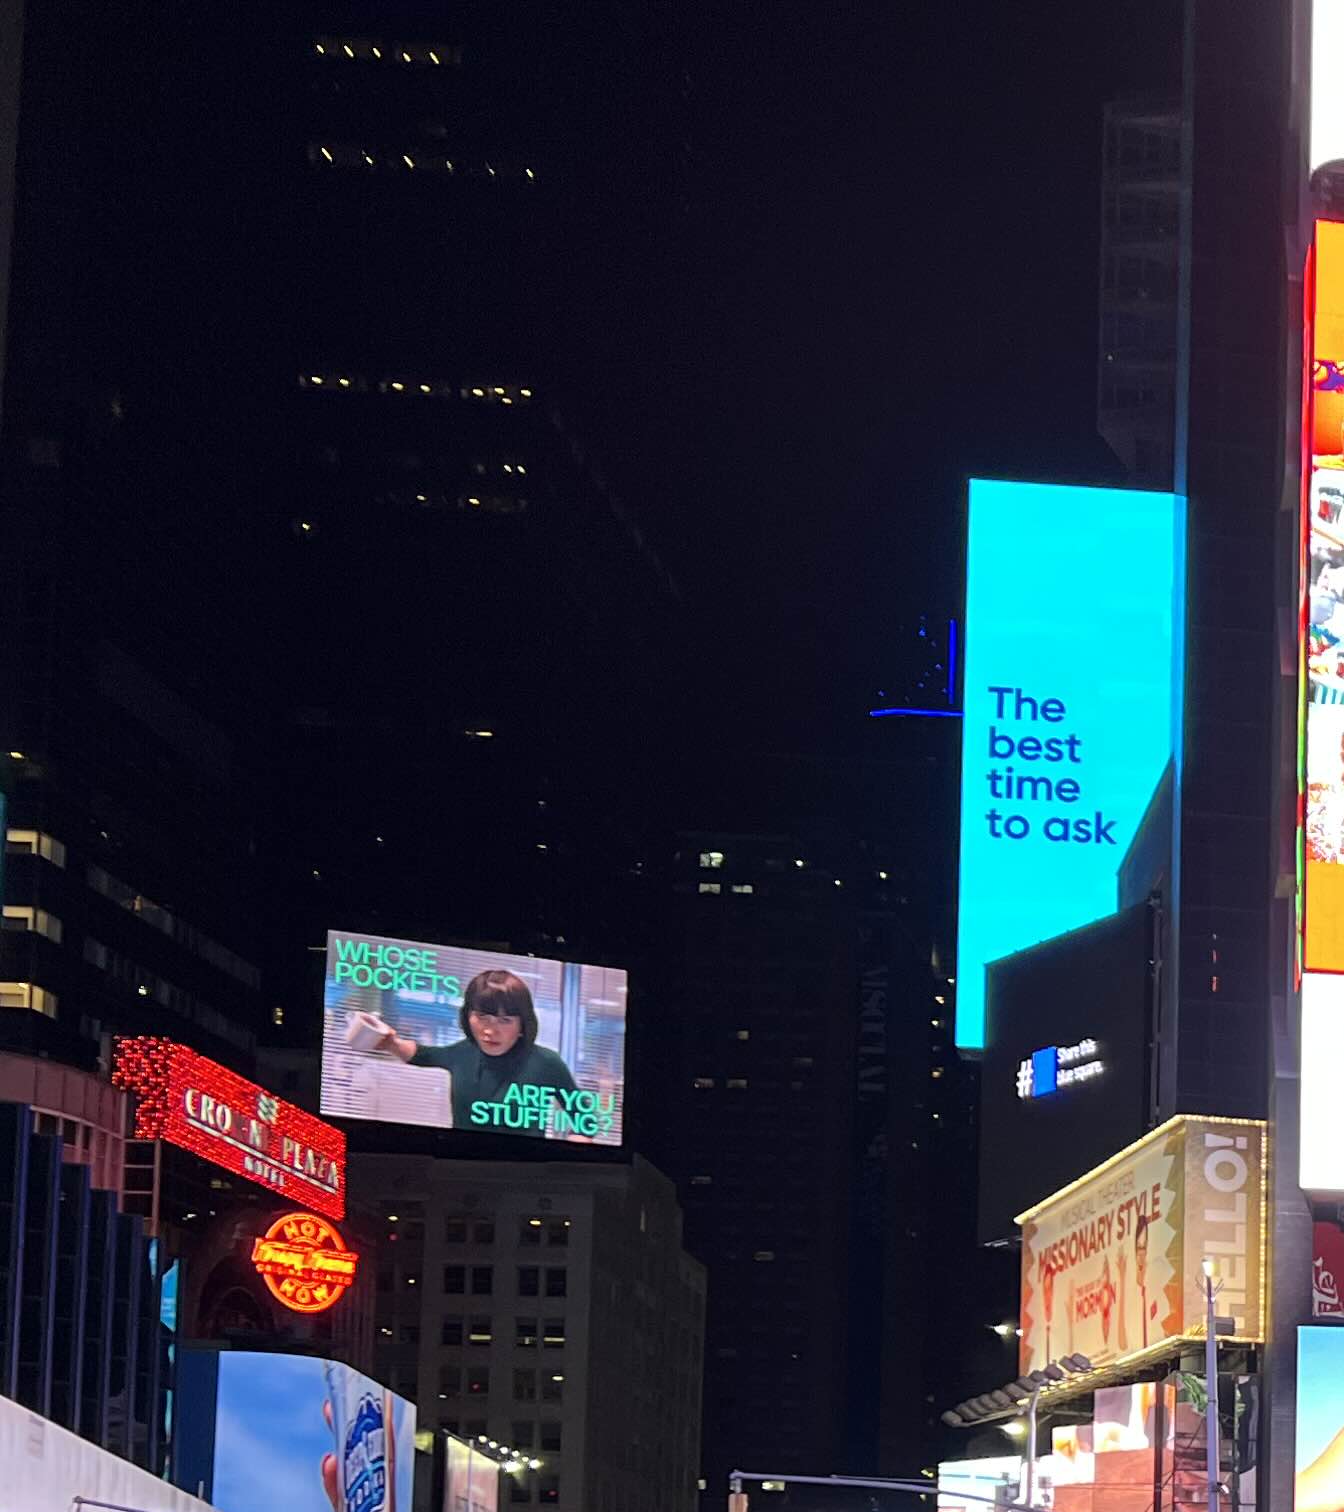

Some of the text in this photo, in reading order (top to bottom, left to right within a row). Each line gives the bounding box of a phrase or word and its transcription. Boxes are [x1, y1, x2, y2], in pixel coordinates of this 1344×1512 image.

[987, 686, 1066, 723] The
[988, 726, 1082, 764] best
[986, 765, 1082, 803] time
[985, 808, 1118, 845] to ask
[334, 938, 439, 975] WHOSE
[334, 962, 462, 998] POCKETS
[503, 1083, 615, 1117] ARE YOU
[469, 1100, 615, 1138] STUFFING?
[1037, 1182, 1163, 1284] MISSIONARY STYLE
